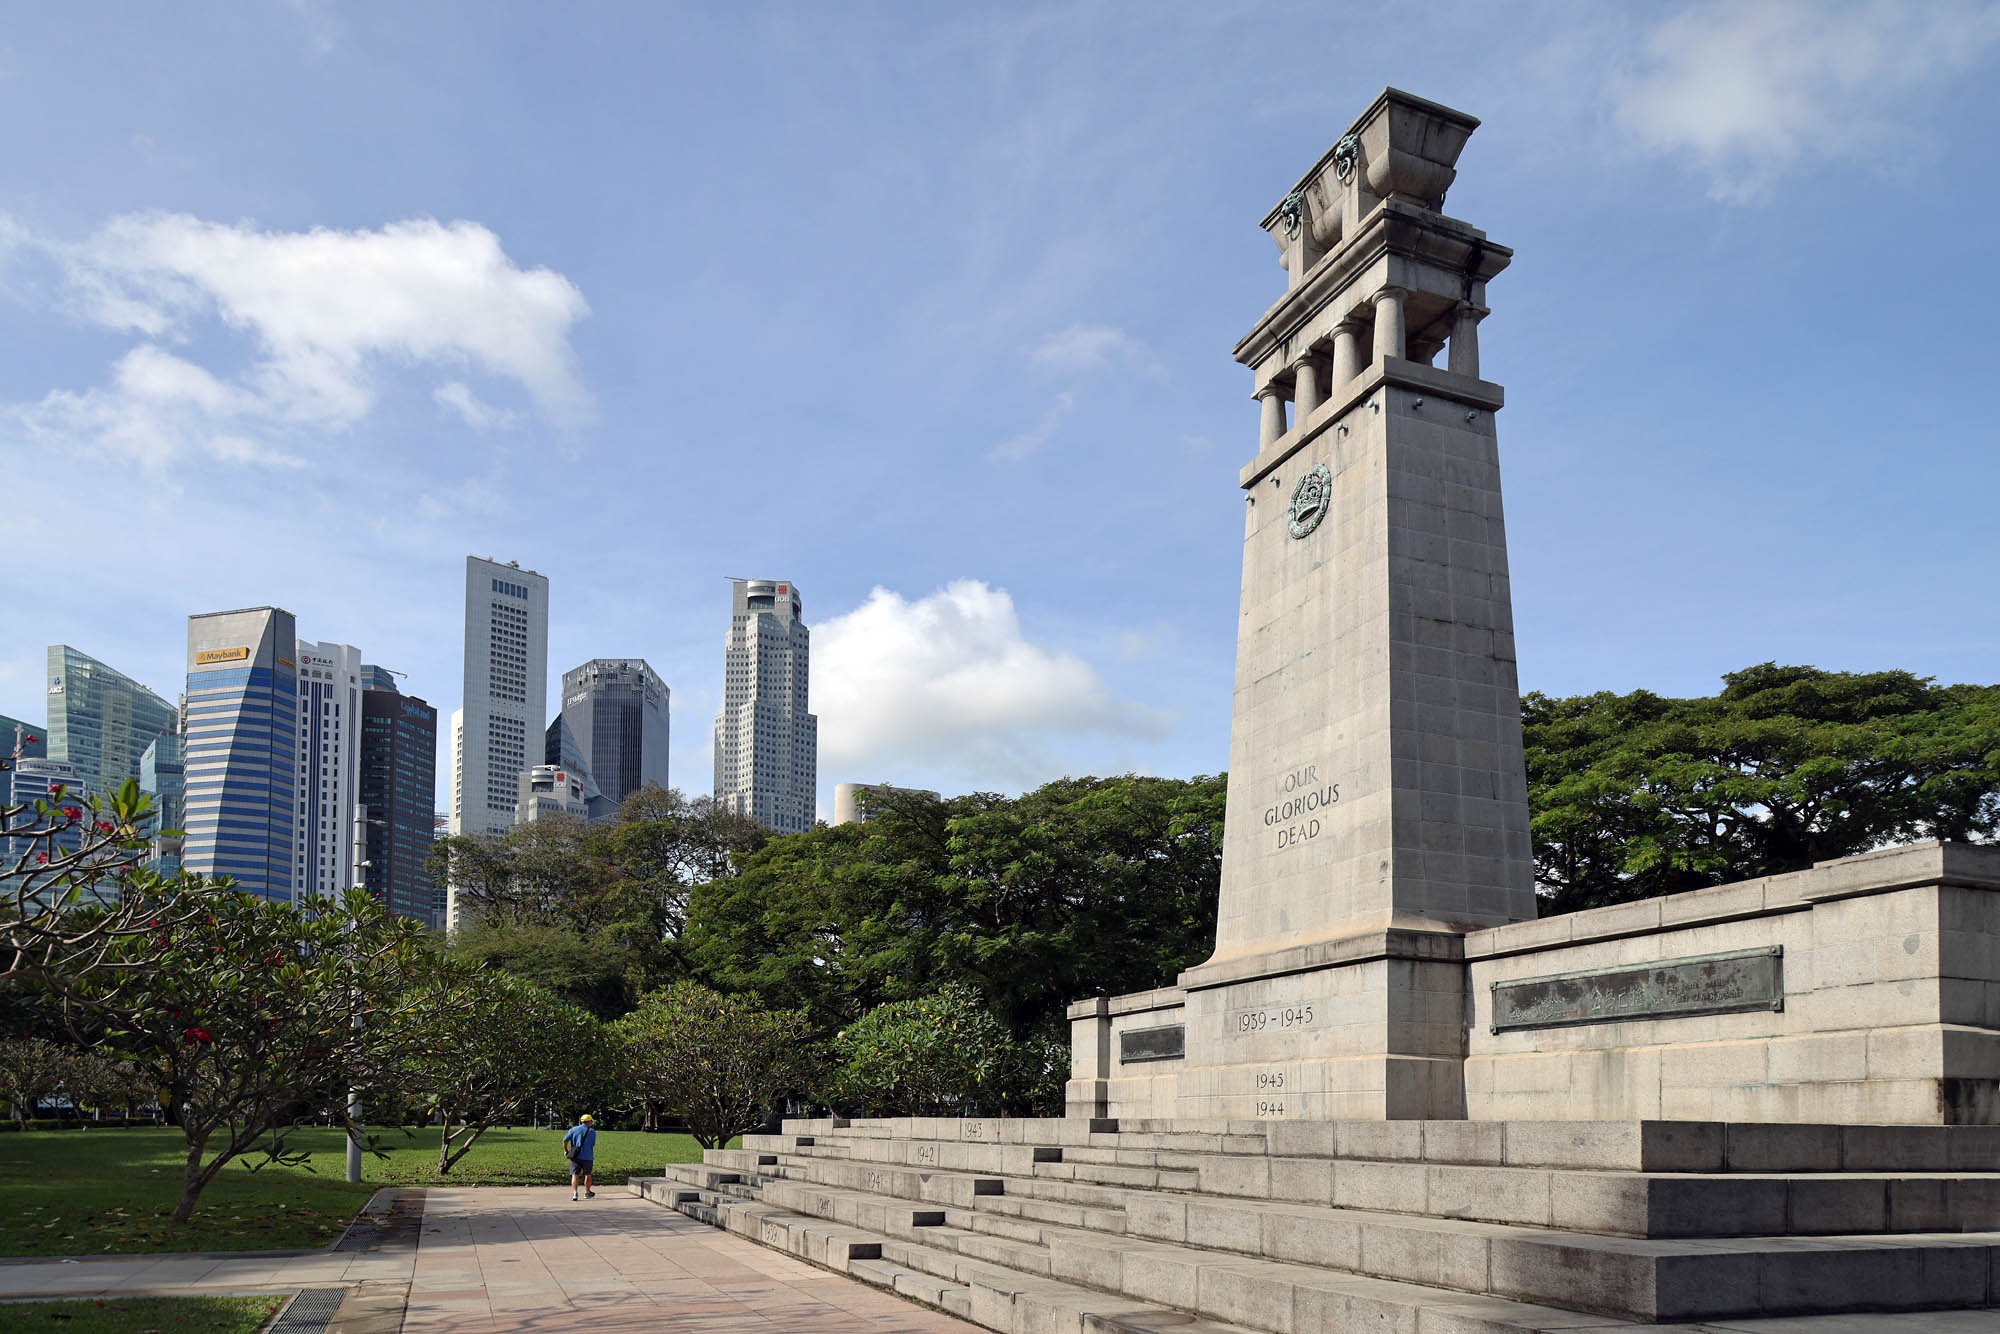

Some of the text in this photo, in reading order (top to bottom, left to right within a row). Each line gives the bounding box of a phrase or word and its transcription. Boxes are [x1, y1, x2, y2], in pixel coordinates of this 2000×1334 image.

[207, 650, 243, 660] Maybank
[1285, 765, 1319, 793] OUR
[1264, 783, 1340, 826] GLORIOUS
[1278, 819, 1321, 849] DEAD
[1238, 1011, 1267, 1032] 1939
[1281, 1006, 1313, 1028] 1945
[1256, 1072, 1284, 1089] 1945
[1256, 1101, 1285, 1117] 1944
[964, 1121, 983, 1138] 1943
[917, 1146, 934, 1162] 1942
